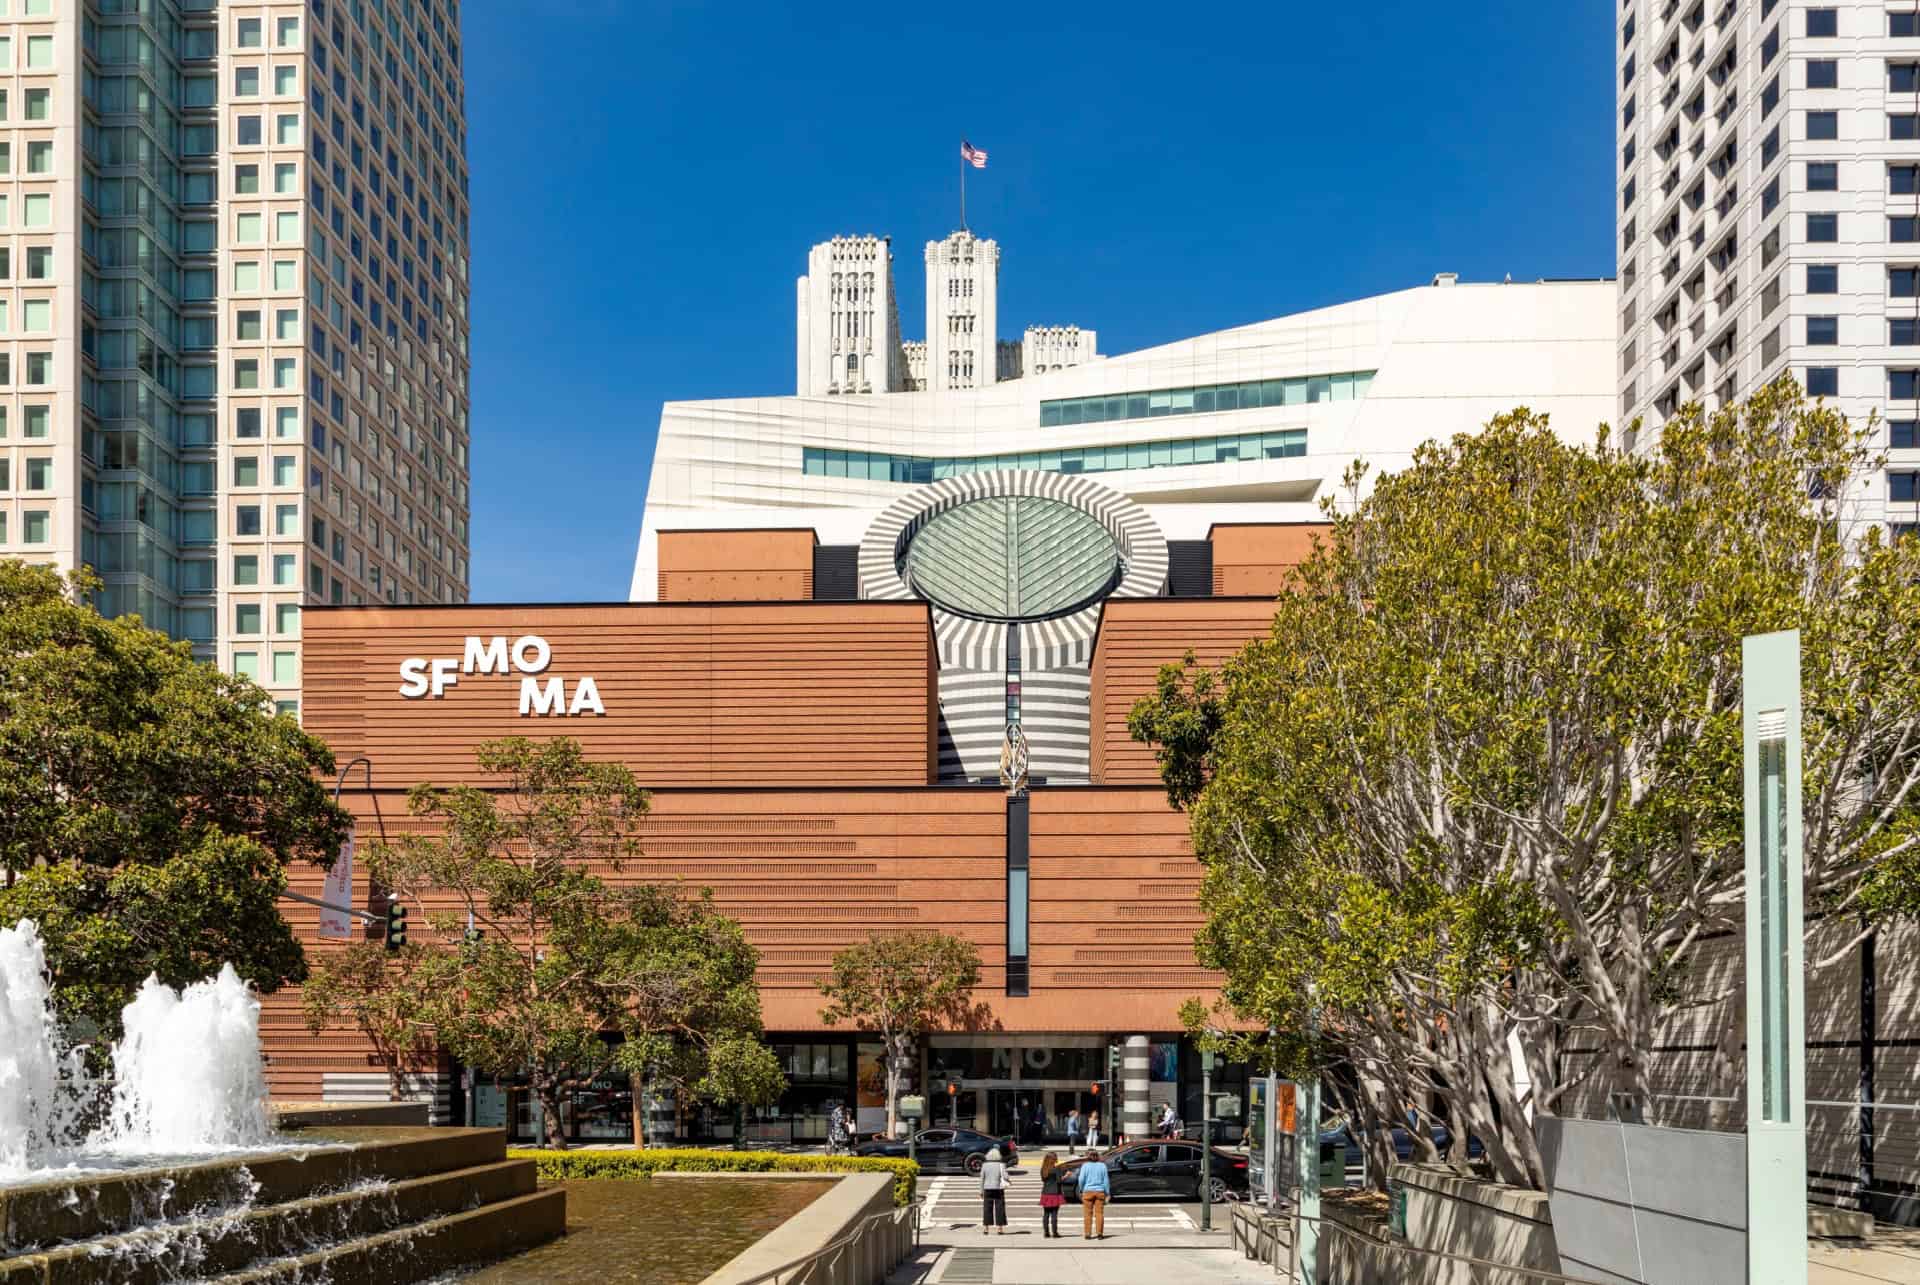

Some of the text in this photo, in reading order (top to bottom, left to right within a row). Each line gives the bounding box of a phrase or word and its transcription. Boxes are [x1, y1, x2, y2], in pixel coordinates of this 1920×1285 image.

[399, 635, 605, 715] SF MO MA
